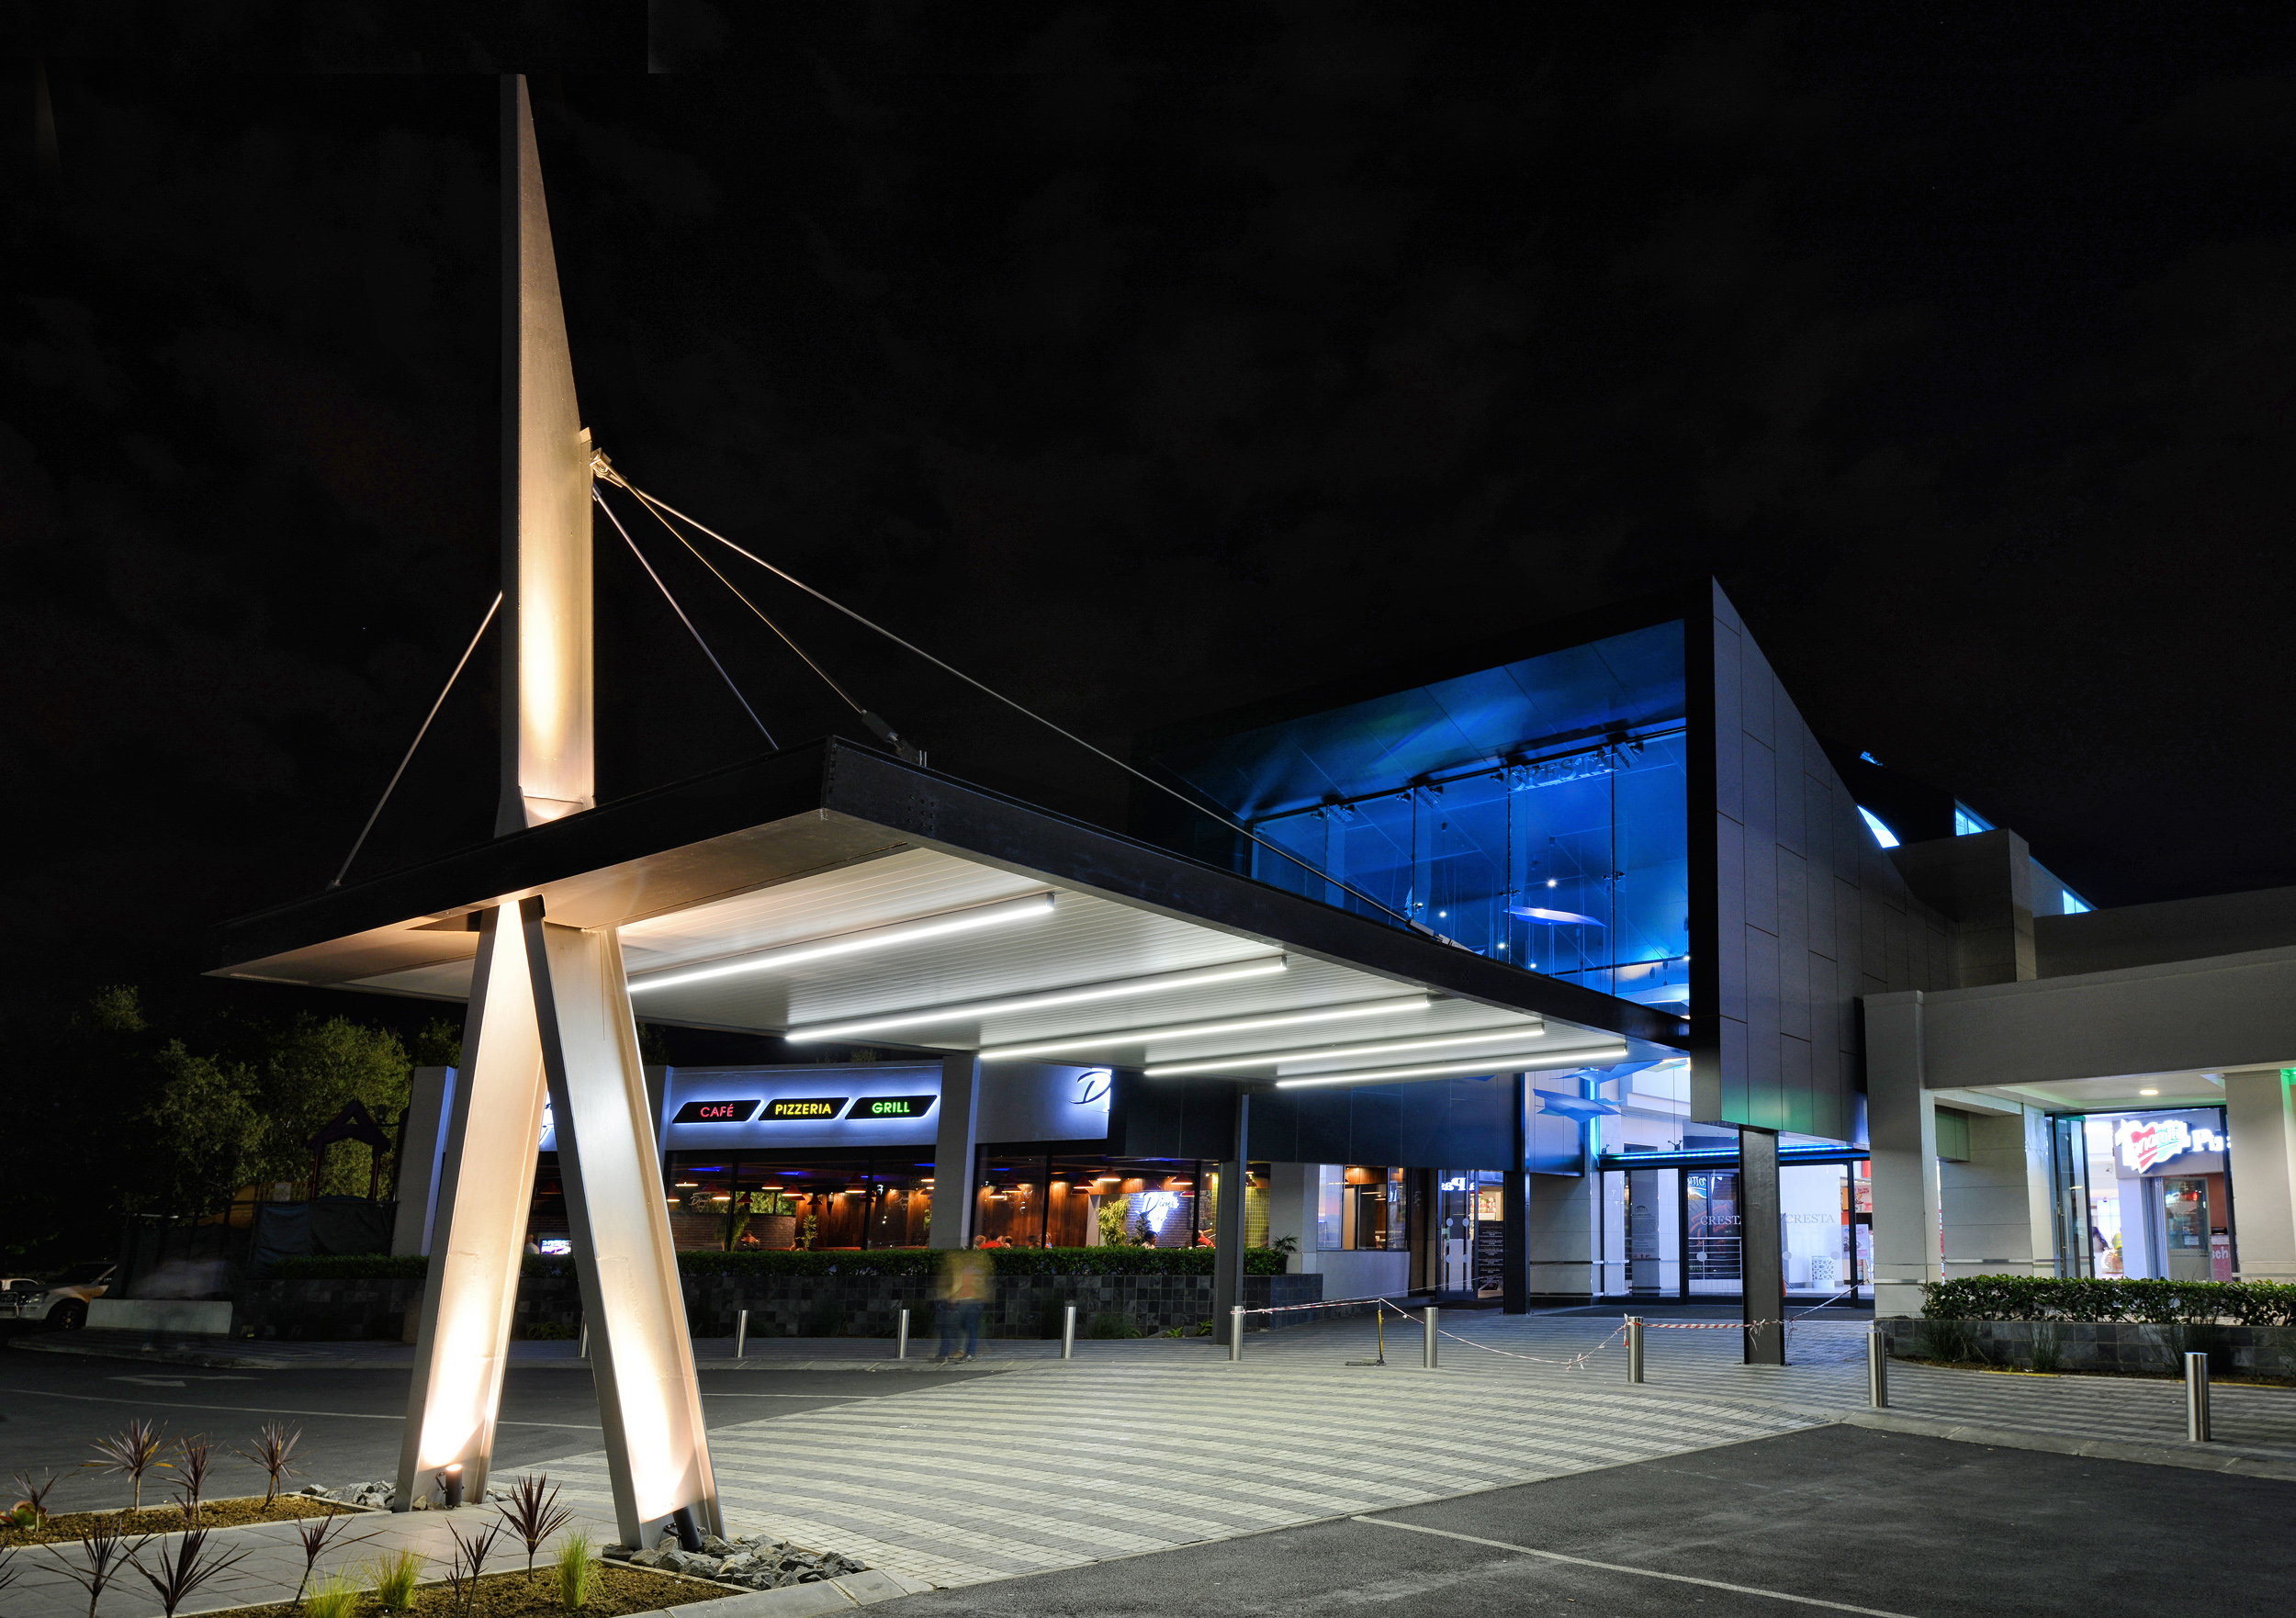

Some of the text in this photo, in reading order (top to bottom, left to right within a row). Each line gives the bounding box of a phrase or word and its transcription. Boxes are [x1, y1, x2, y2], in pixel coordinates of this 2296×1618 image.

[1507, 752, 1613, 791] CRESTA
[700, 1101, 910, 1118] CAFÉ PIZZERIA GRILL
[1700, 1215, 1741, 1225] CREST
[1785, 1214, 1835, 1223] CRESTA
